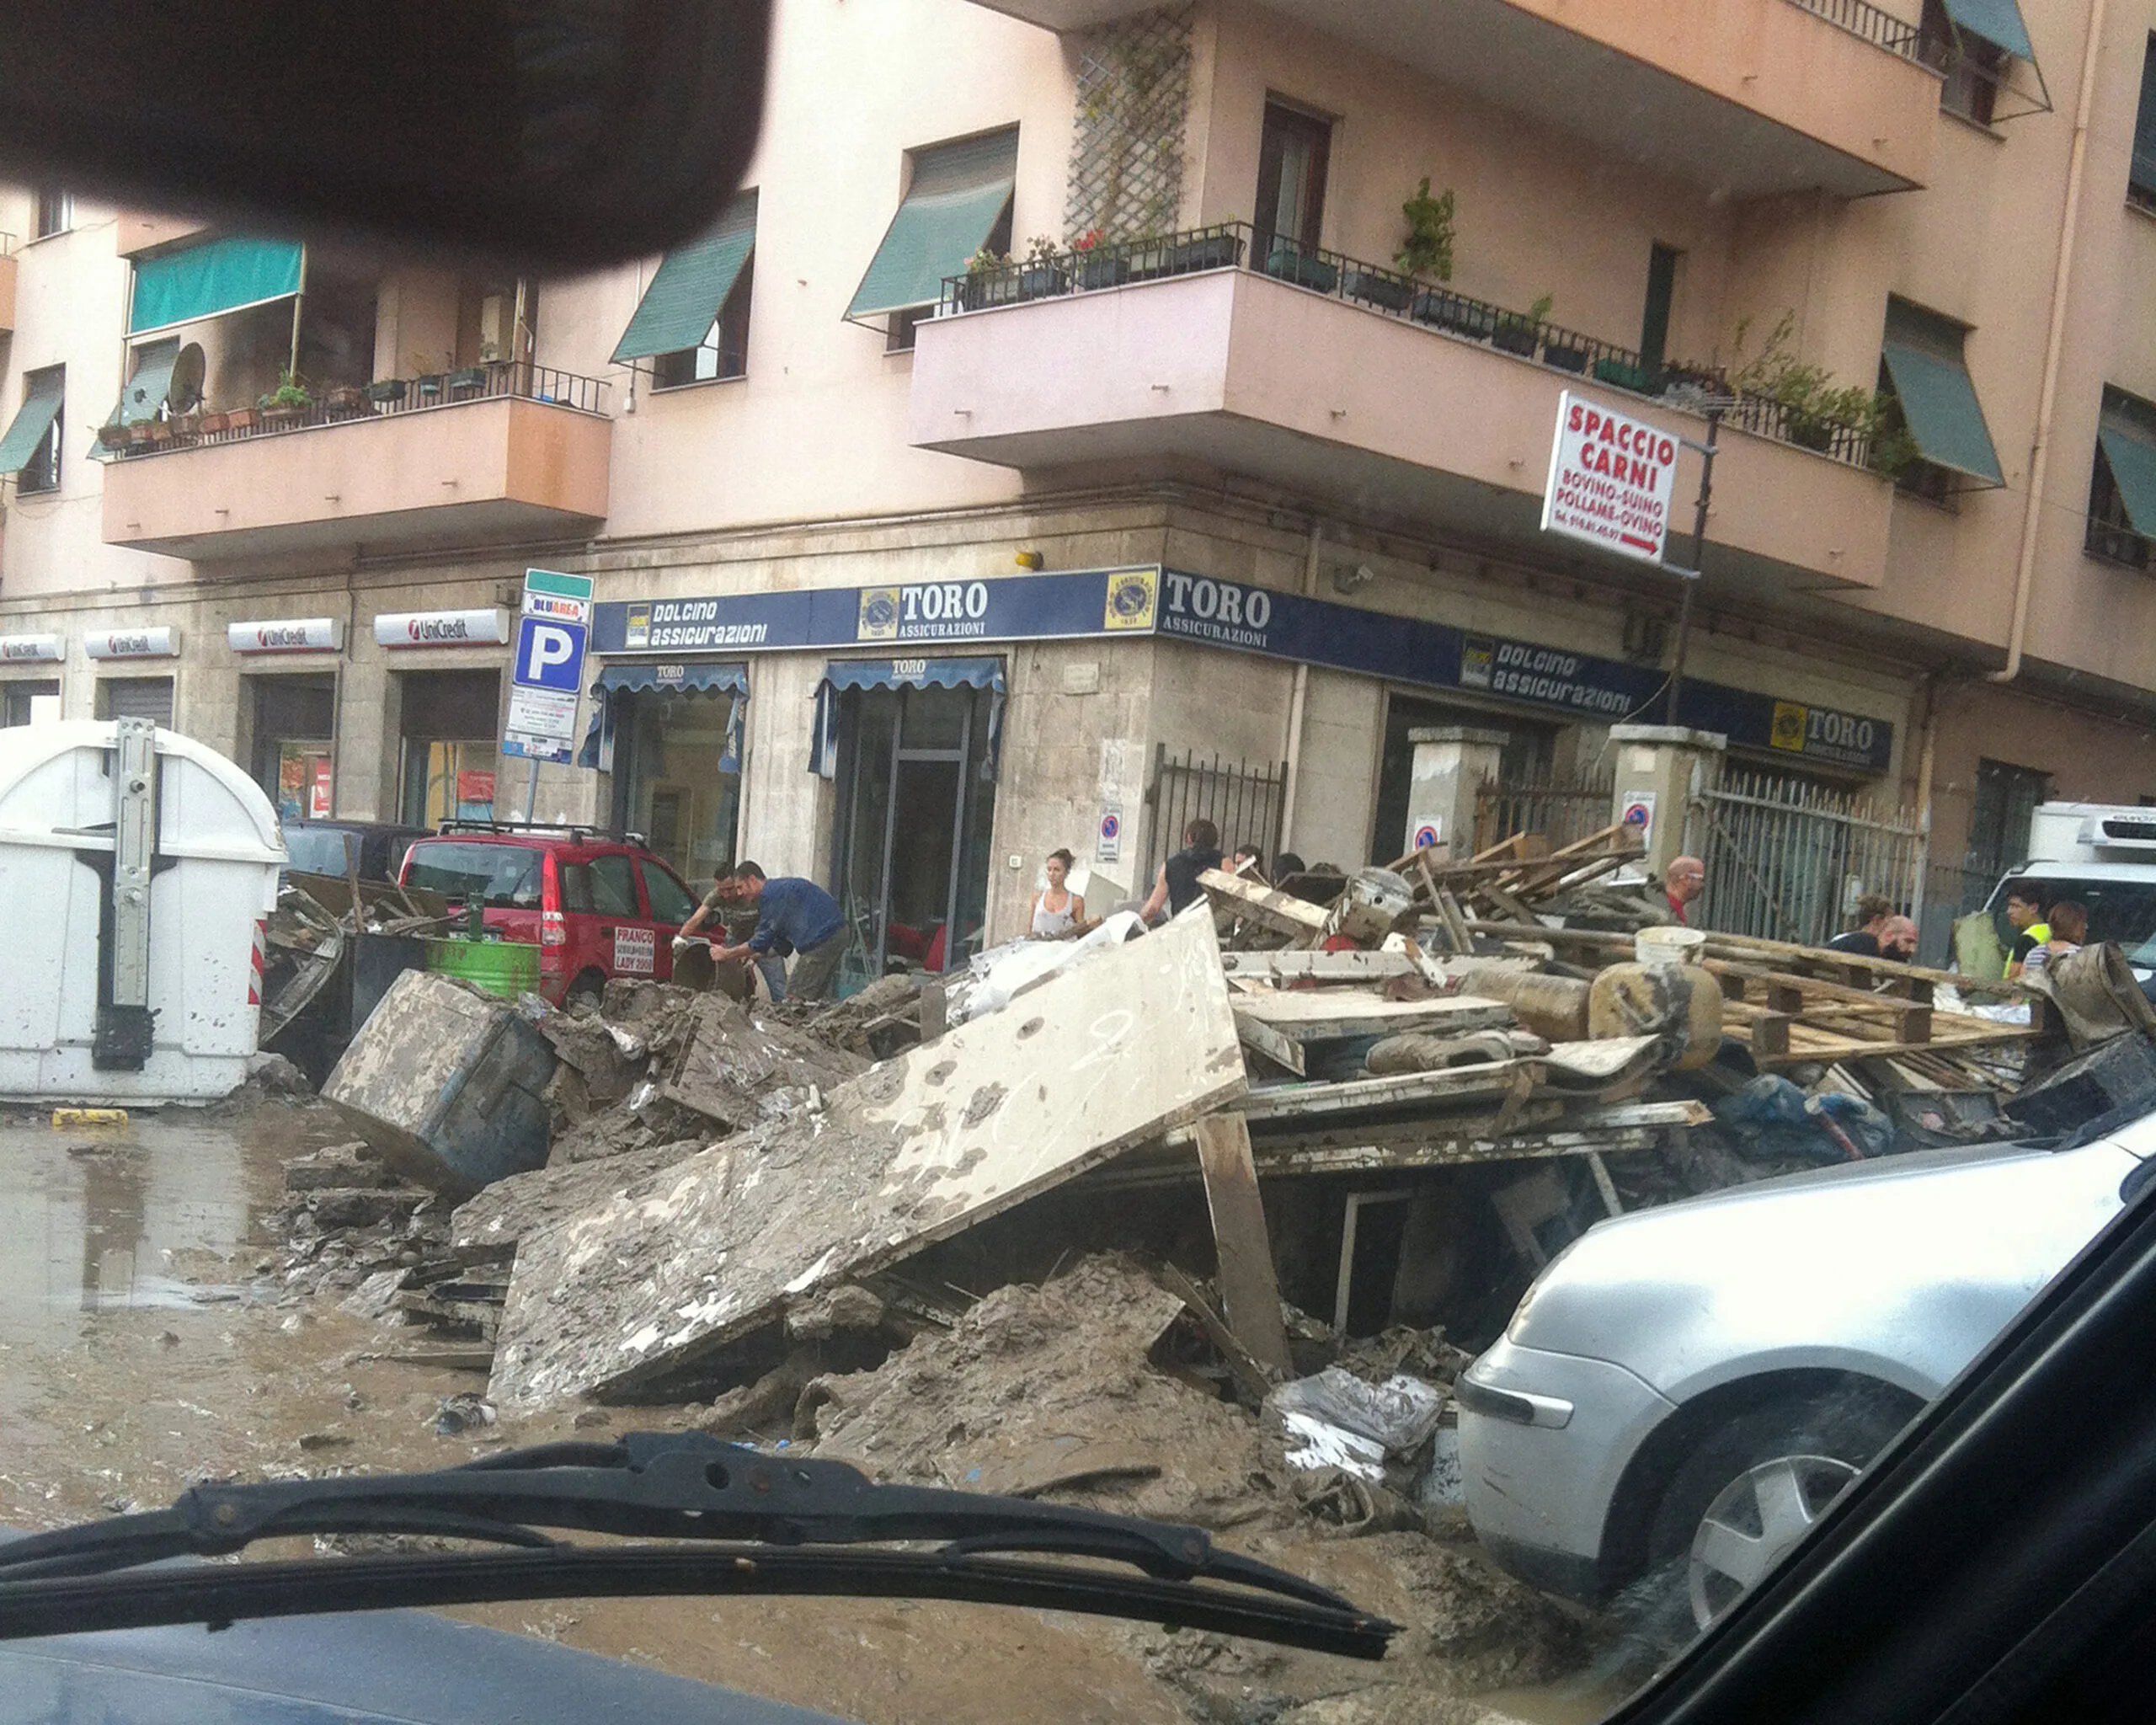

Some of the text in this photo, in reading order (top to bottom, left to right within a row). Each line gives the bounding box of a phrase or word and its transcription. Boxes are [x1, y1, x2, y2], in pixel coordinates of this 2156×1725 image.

[1568, 405, 1674, 466] SPACCIO
[1581, 442, 1658, 492] CARNI
[902, 582, 988, 621] TORO
[1166, 573, 1271, 629] TORO
[267, 628, 308, 645] UniCredit
[420, 618, 468, 639] UniCredit
[899, 622, 985, 638] ASSICURAZIONI
[1163, 617, 1267, 648] ASSICURAZIONI
[528, 625, 574, 681] P
[892, 660, 926, 674] TORO
[657, 665, 685, 678] TORO
[1808, 709, 1874, 750] TORO
[617, 929, 654, 943] FRANCO
